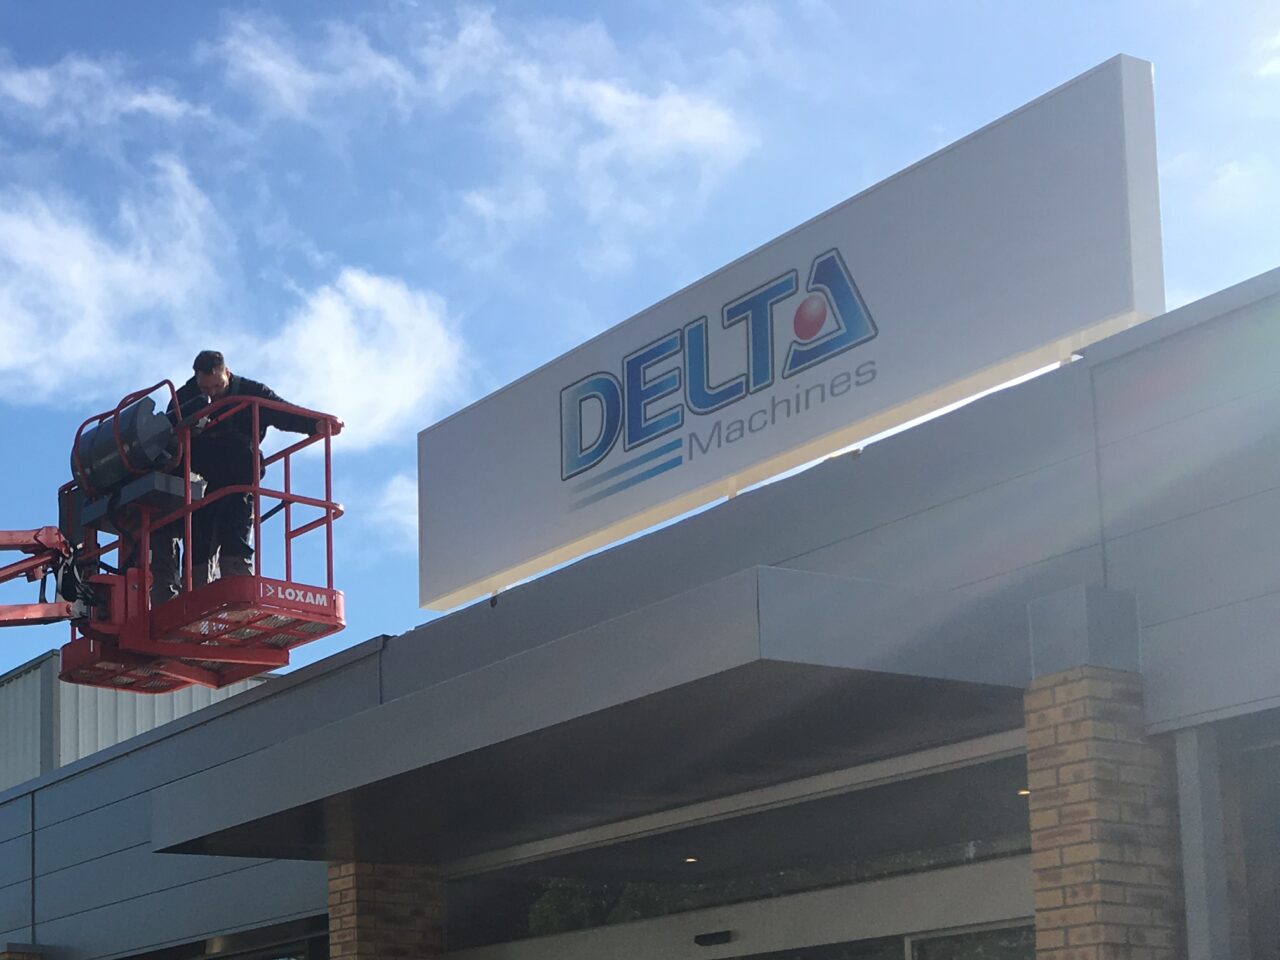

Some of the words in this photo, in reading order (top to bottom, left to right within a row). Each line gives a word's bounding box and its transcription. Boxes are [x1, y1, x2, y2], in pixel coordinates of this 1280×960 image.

[560, 247, 878, 481] DELTA
[687, 360, 878, 462] Machines
[277, 587, 328, 607] LOXAM
